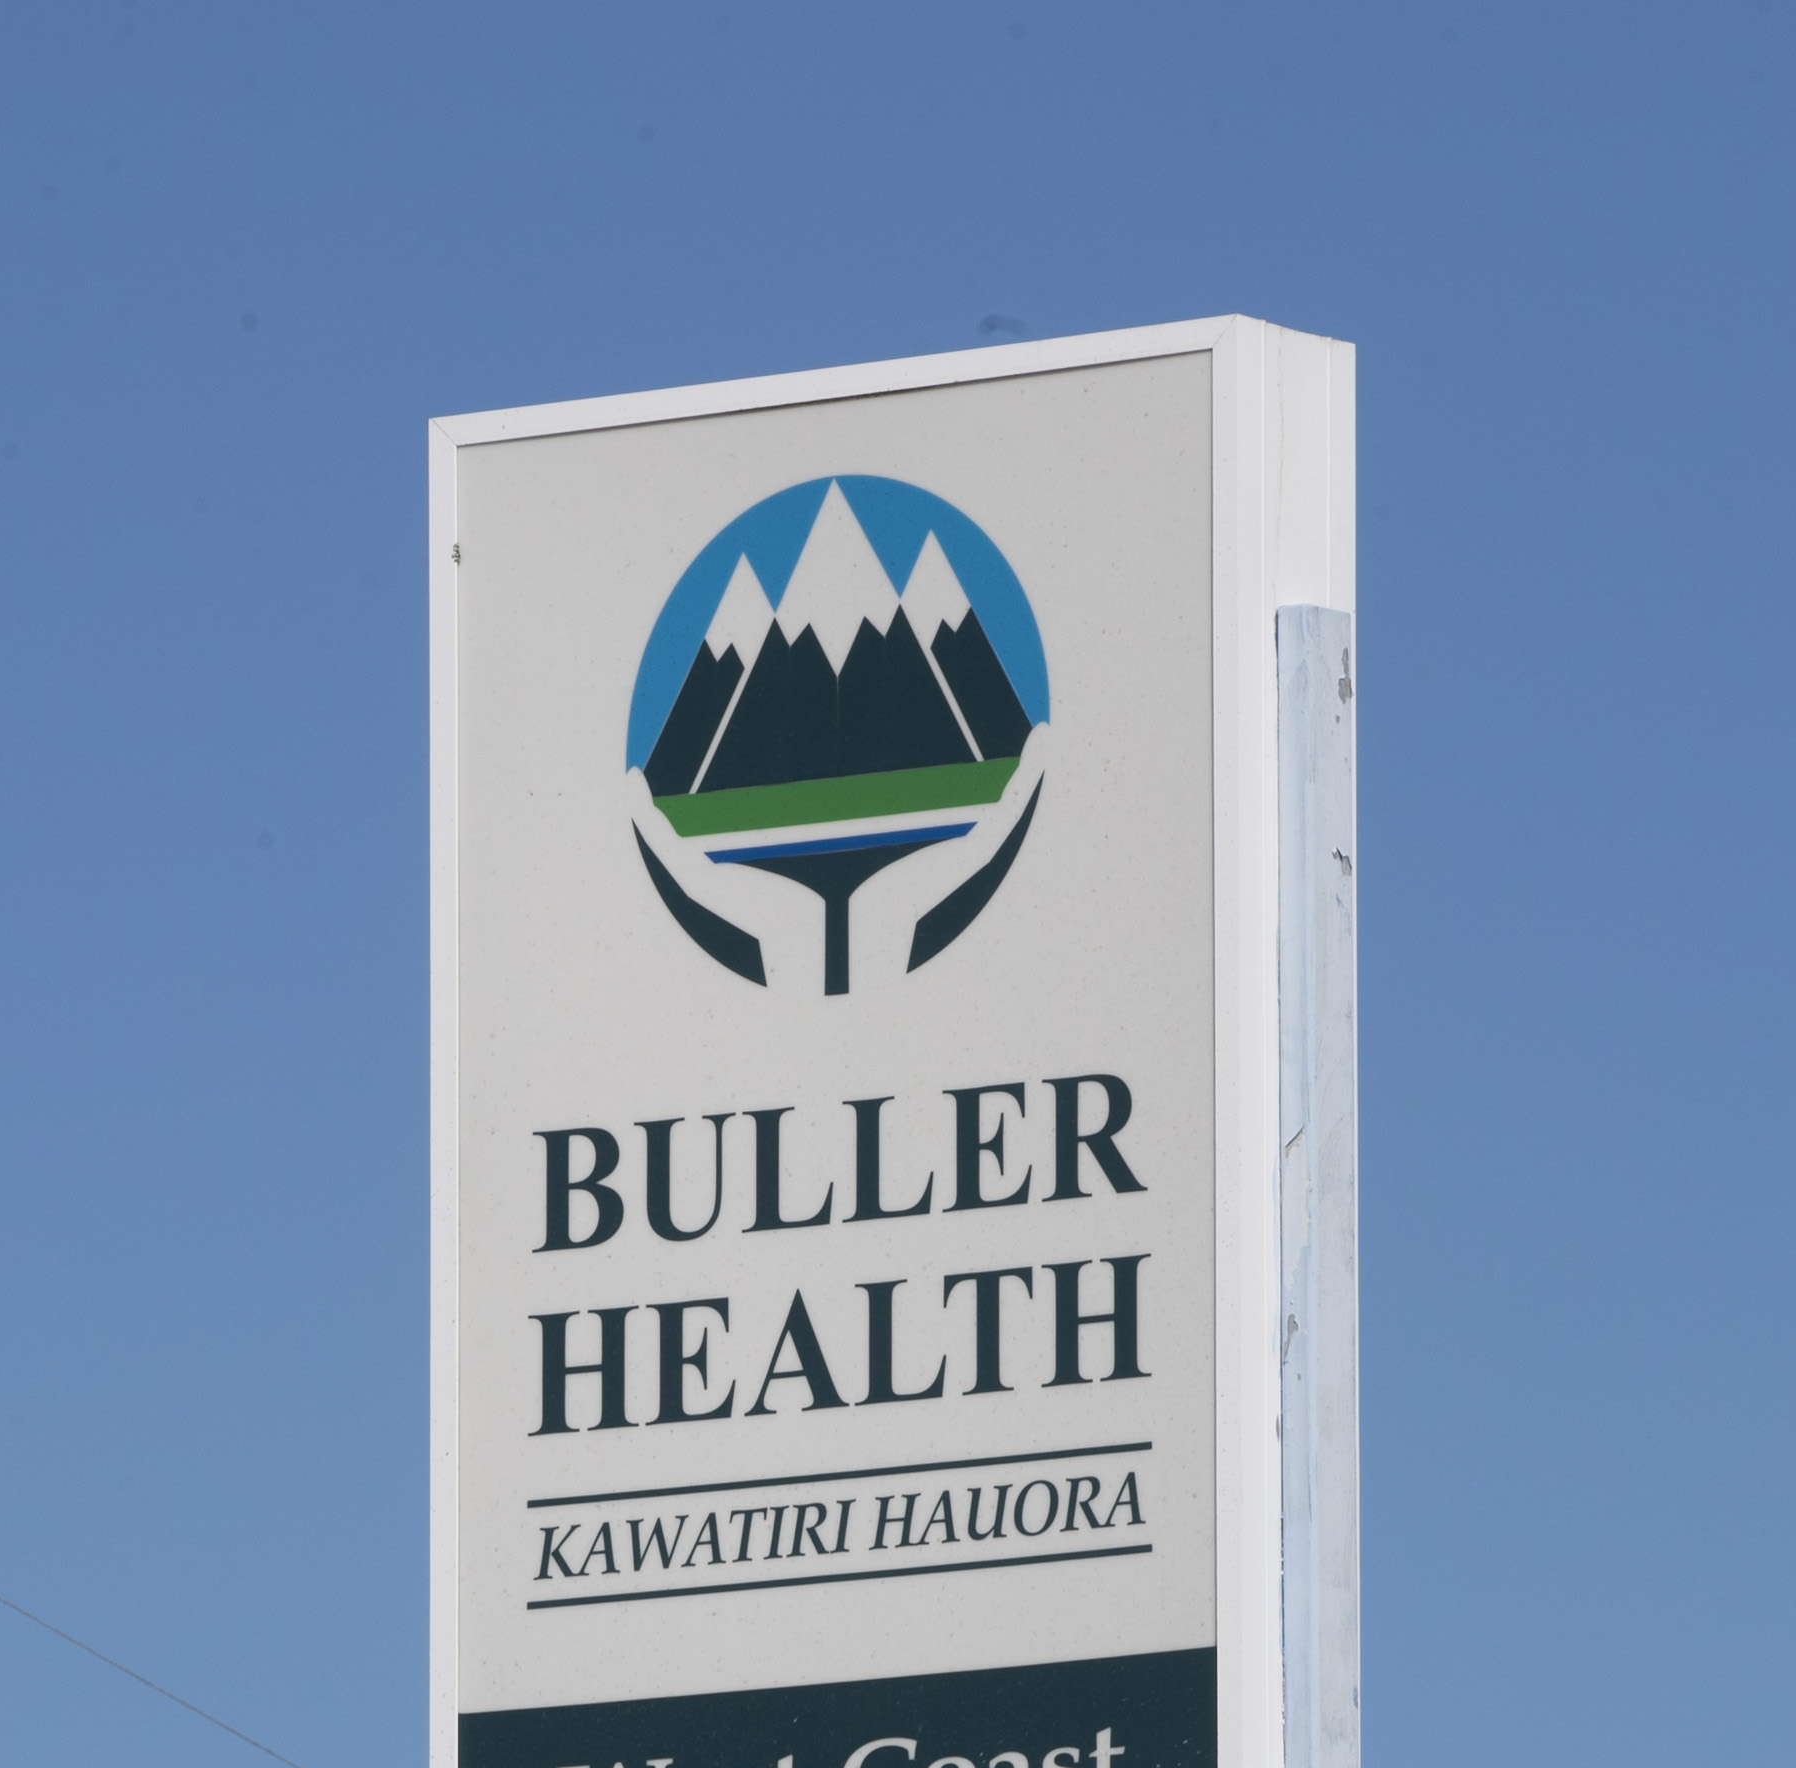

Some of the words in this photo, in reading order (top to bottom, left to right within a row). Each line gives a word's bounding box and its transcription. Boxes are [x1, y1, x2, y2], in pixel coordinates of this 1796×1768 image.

[531, 1073, 1148, 1254] BULLER
[528, 1252, 1152, 1437] HEALTH
[532, 1498, 858, 1581] KAWATIRI
[868, 1471, 1147, 1551] HAUORA
